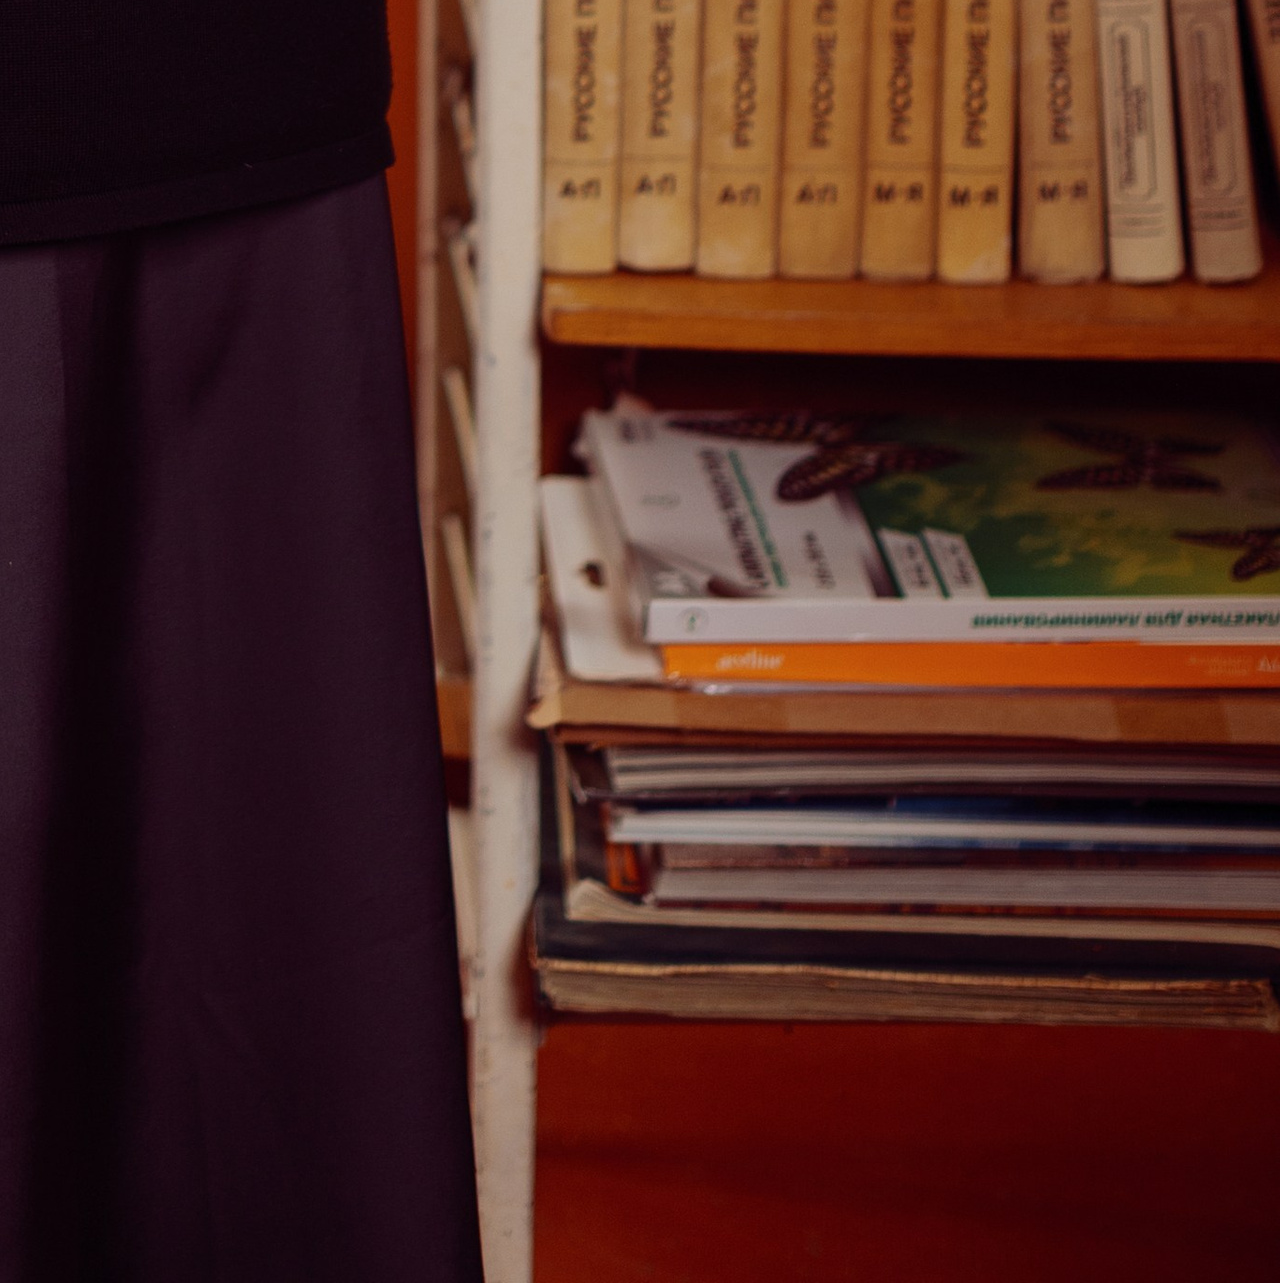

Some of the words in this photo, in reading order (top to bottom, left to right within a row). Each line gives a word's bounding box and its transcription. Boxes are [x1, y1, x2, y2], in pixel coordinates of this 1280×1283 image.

[573, 23, 597, 143] РУССКИЕ
[650, 20, 675, 139] РУССКИЕ
[733, 28, 760, 149] РУССКИЕ
[811, 29, 839, 149] РУССКИЕ
[888, 26, 915, 146] РУССКИЕ
[962, 26, 990, 149] РУССКИЕ
[1048, 27, 1072, 145] РУССКИЕ
